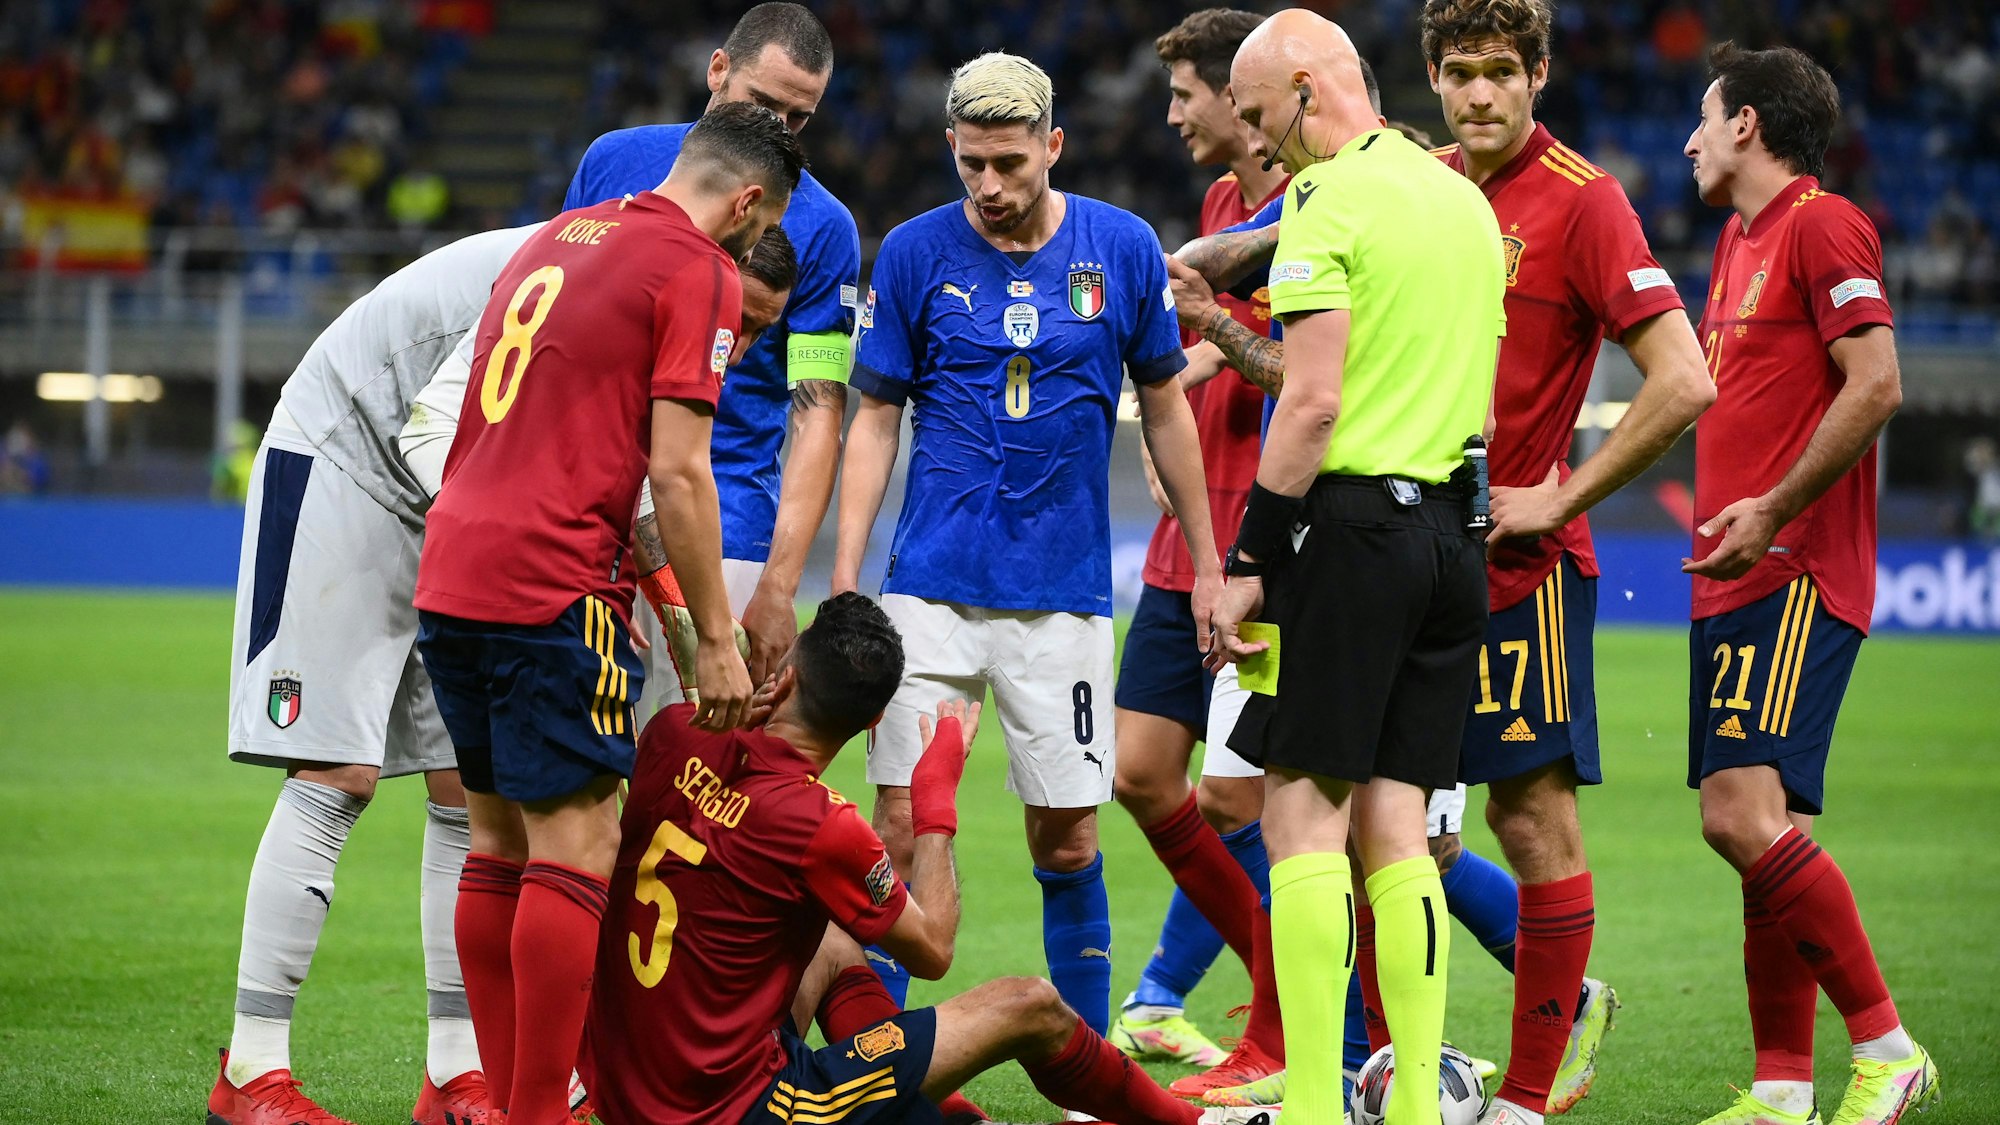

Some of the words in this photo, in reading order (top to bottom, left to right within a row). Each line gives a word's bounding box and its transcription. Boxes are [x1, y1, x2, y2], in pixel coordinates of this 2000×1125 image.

[555, 217, 621, 244] KOKE
[1071, 273, 1101, 282] ITALIA
[479, 264, 564, 425] 8
[798, 349, 844, 362] RESPECT
[1005, 355, 1031, 419] 8
[272, 681, 299, 691] ITALIA
[1474, 639, 1529, 714] 17
[1710, 642, 1756, 711] 21
[1072, 680, 1093, 745] 8
[1716, 728, 1747, 740] adidas
[1500, 732, 1537, 742] adidas
[674, 756, 750, 828] SERGIO
[628, 819, 708, 989] 5
[1520, 1014, 1568, 1027] adidas
